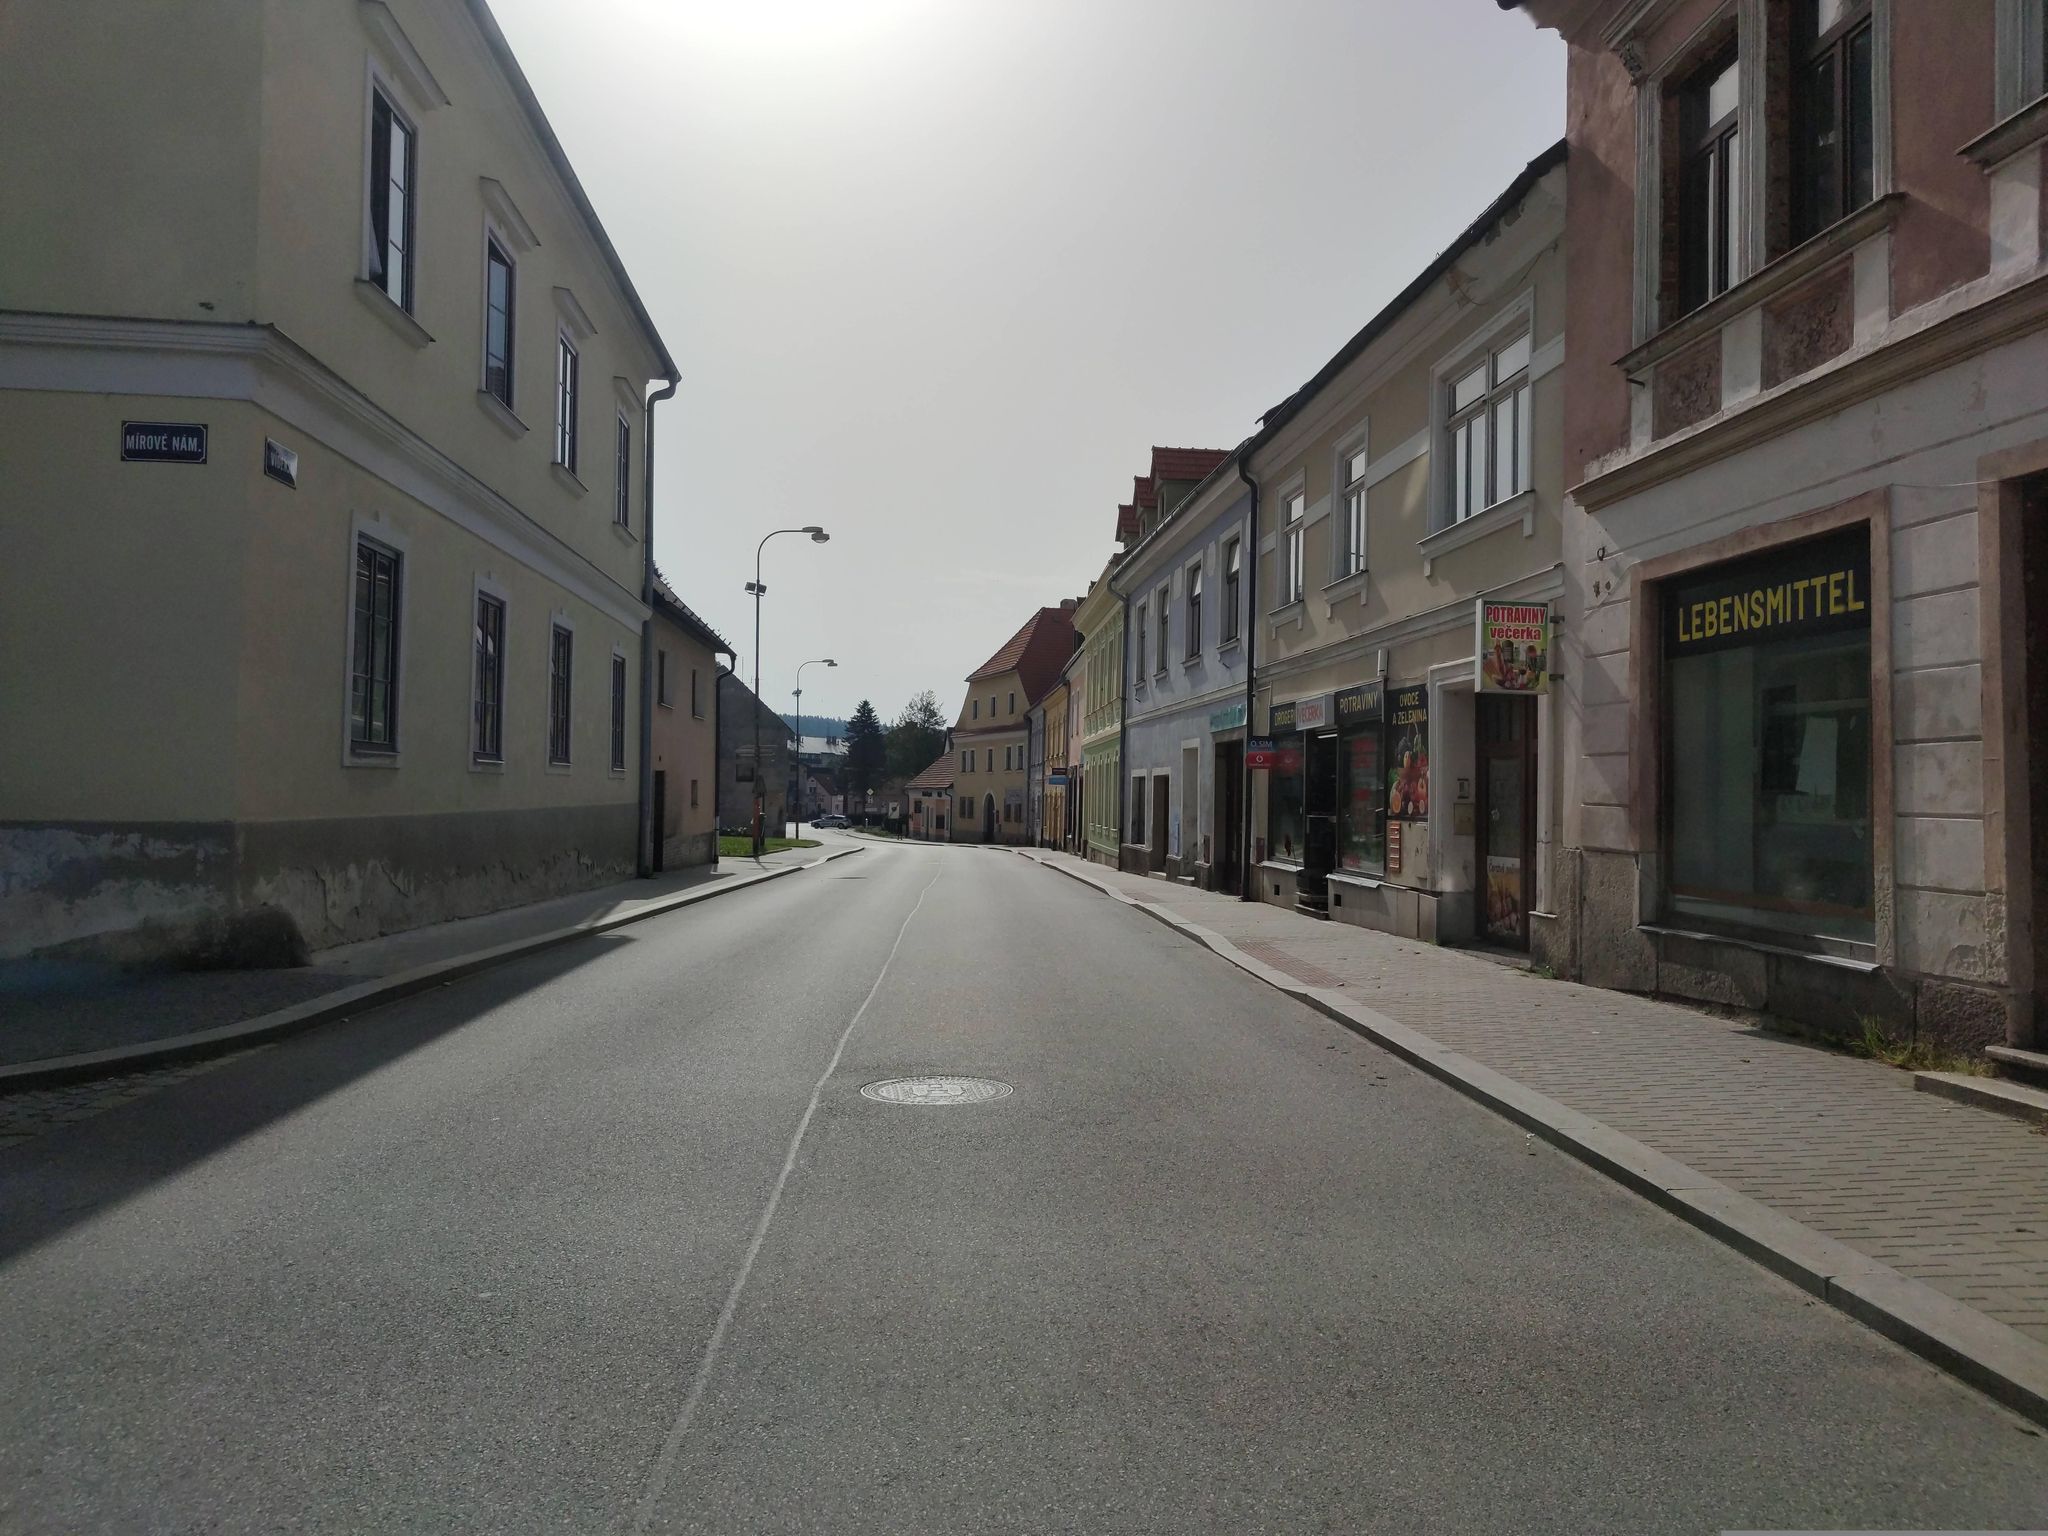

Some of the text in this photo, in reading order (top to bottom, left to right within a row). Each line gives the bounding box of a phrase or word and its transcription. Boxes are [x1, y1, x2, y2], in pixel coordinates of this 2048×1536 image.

[126, 433, 202, 452] MÍROVÉ NÁM.
[1486, 606, 1546, 625] POTRAVINY
[1679, 570, 1865, 642] LEBENSMITTEL
[1490, 625, 1541, 641] večerka
[1339, 692, 1378, 713] POTRAVINY
[1399, 692, 1419, 707] OVOCE
[1392, 708, 1427, 726] A ZELENINA
